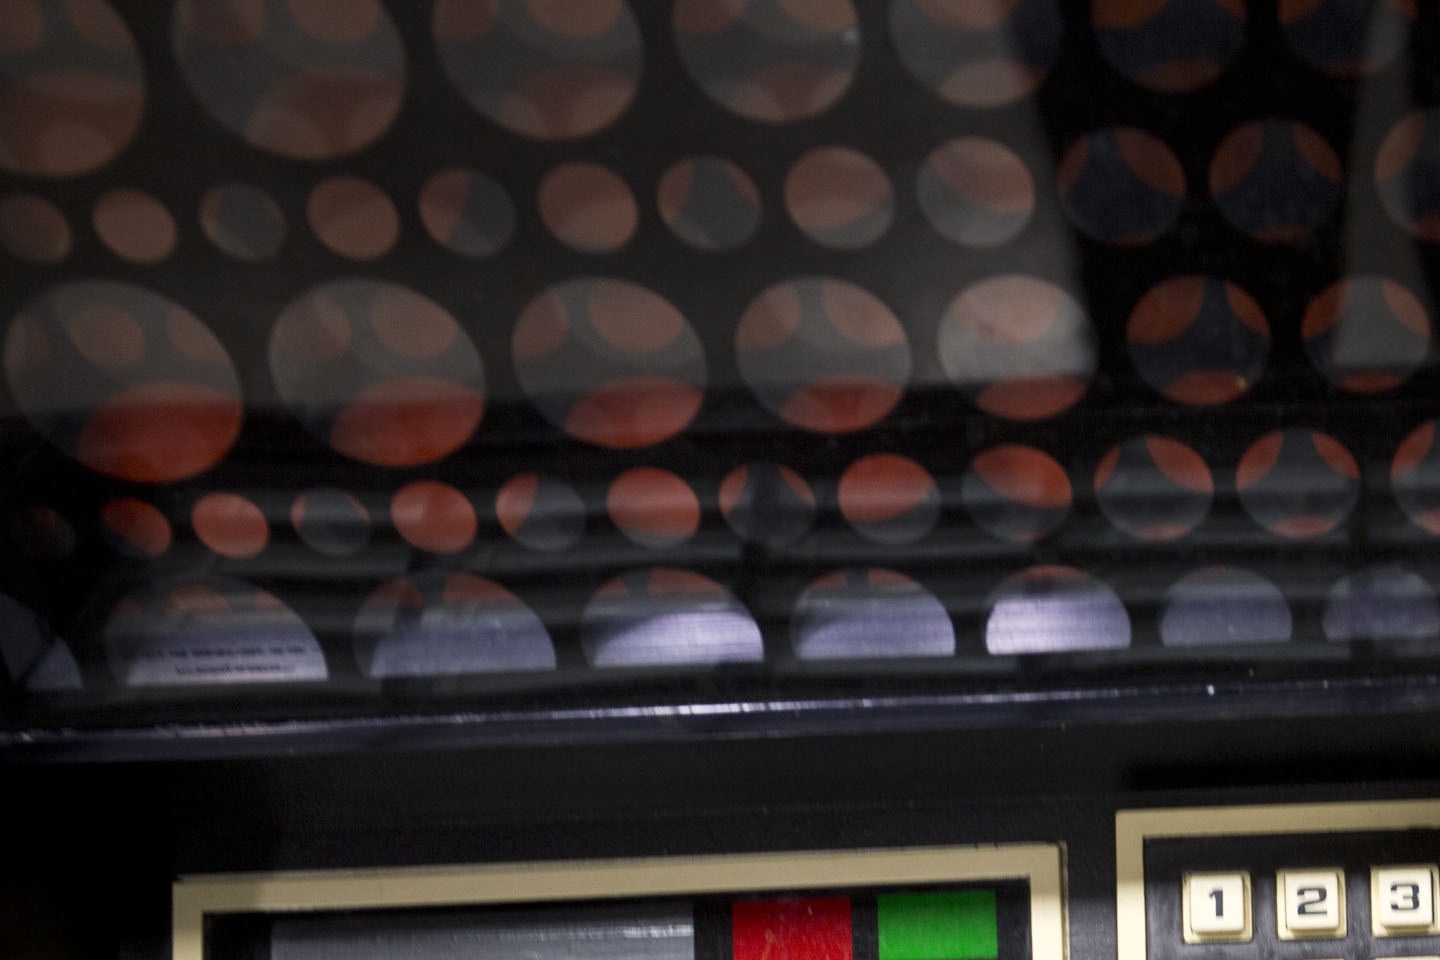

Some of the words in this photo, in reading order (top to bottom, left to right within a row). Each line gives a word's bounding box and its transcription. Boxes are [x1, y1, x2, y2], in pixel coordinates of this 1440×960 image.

[1208, 889, 1224, 917] 1
[1297, 887, 1328, 916] 2
[1390, 883, 1421, 912] 3
